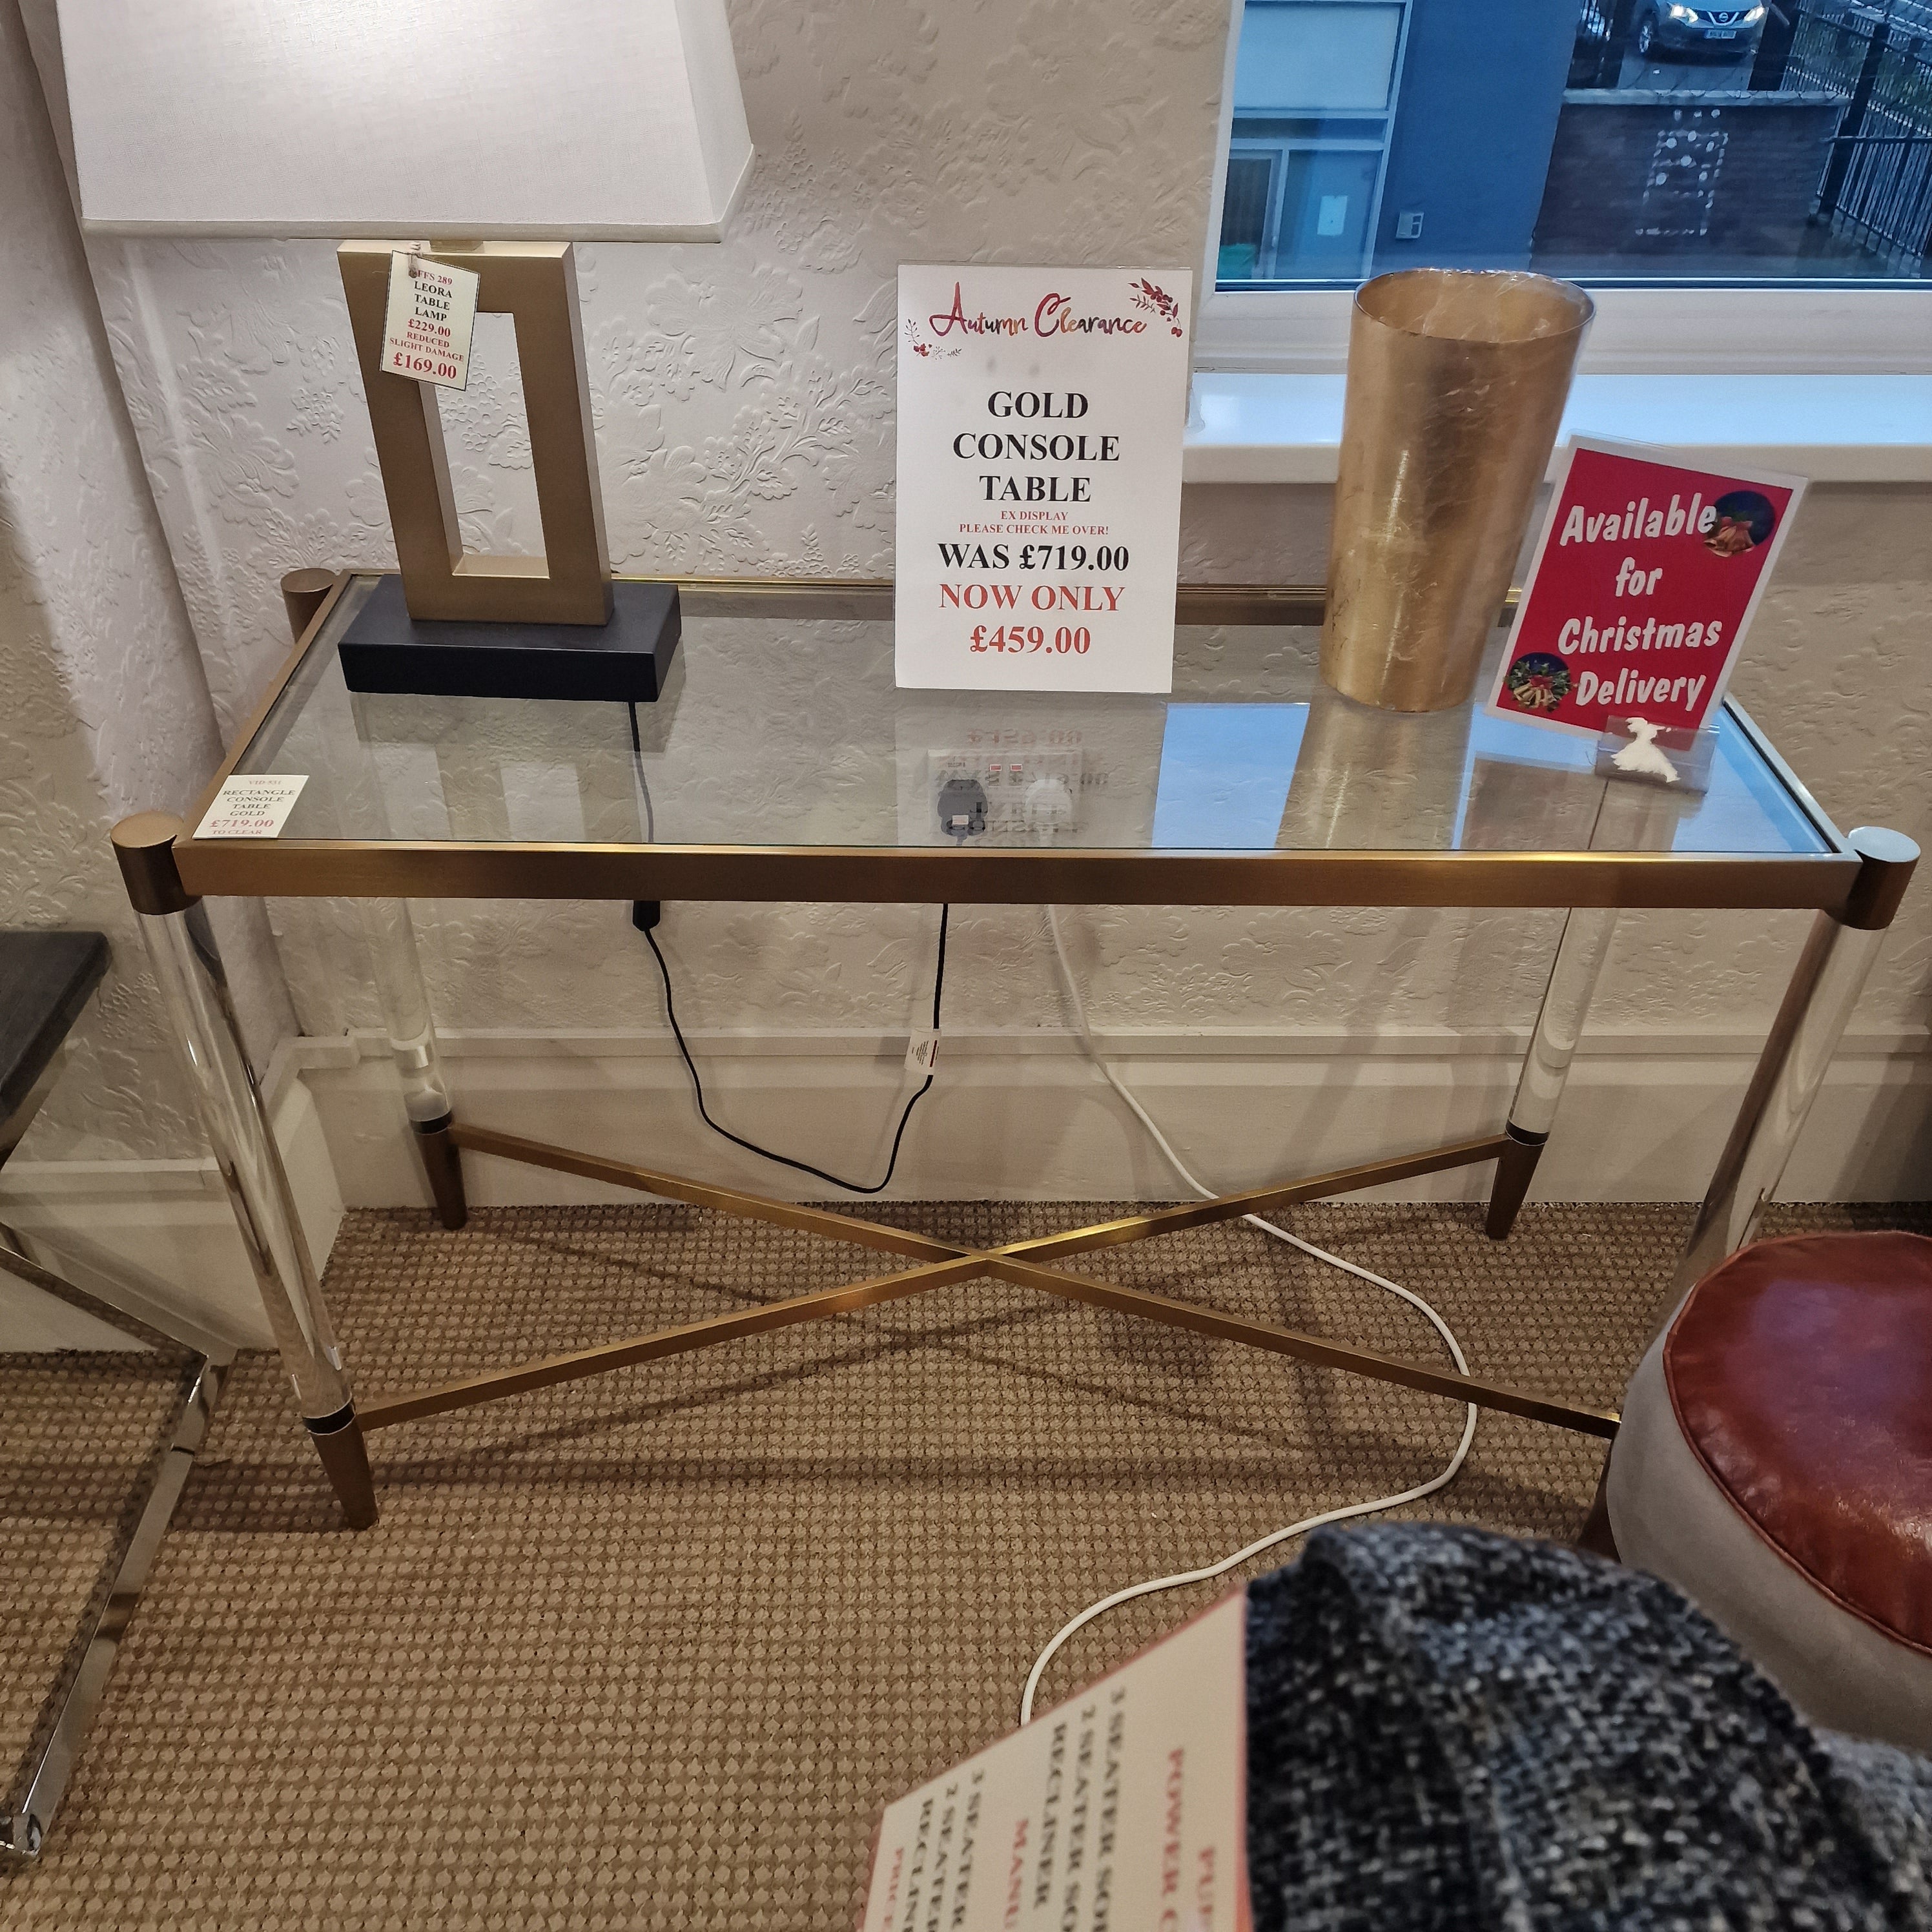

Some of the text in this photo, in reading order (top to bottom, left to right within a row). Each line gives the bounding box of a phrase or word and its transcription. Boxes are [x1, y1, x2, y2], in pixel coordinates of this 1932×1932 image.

[414, 281, 453, 298] LEORA
[437, 275, 453, 285] 289
[415, 293, 450, 310] TABLE
[415, 306, 447, 321] LAMP
[929, 282, 1147, 337] Autumn Clearance
[407, 331, 449, 347] REDUCED
[408, 318, 451, 337] £229.00
[390, 338, 464, 362] SLIGHT DAMAGE
[393, 352, 457, 379] £169.00
[988, 391, 1089, 419] GOLD
[953, 433, 1120, 462] CONSOLE
[979, 475, 1091, 502] TABLE
[959, 524, 1109, 535] PLEASE CHECK ME OVER!
[1000, 511, 1069, 521] EX DISPLAY
[1559, 492, 1718, 546] Available
[937, 543, 1129, 571] WAS £719.00
[1615, 557, 1663, 597] for
[938, 583, 1126, 611] NOW ONLY
[970, 624, 1091, 654] £459.00
[1557, 616, 1723, 655] Christmas
[1575, 668, 1707, 712] Delivery
[1111, 1685, 1127, 1705] 3
[1081, 1703, 1097, 1722] 2
[1099, 1711, 1125, 1858] SEATER
[1034, 1721, 1068, 1909] RECLINER
[1067, 1728, 1094, 1875] SEATER
[1162, 1747, 1185, 1898] POWER
[951, 1792, 981, 1929] SEATER
